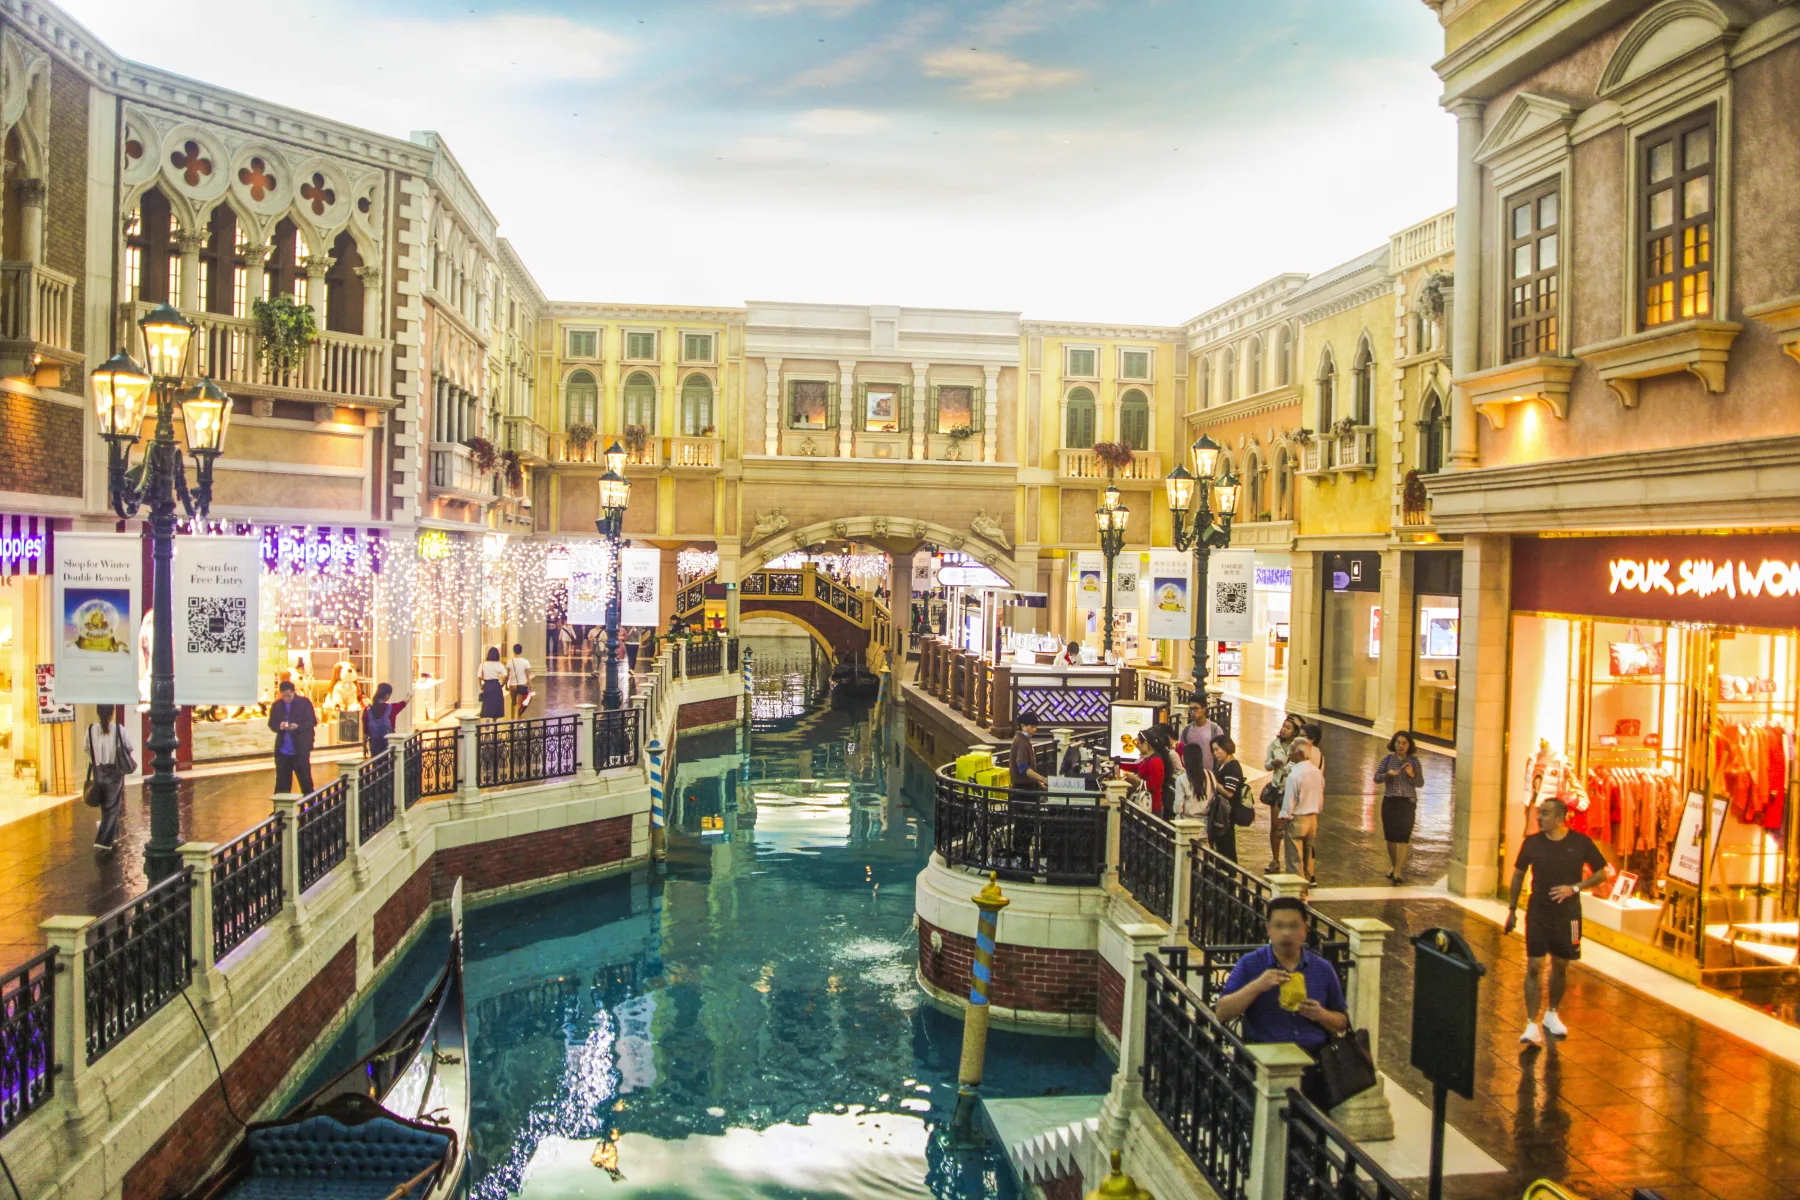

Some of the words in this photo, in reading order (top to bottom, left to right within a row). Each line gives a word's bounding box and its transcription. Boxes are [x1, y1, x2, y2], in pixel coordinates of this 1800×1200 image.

[64, 559, 85, 570] Shop
[87, 560, 98, 568] for
[100, 559, 131, 569] Winter
[196, 562, 221, 572] Scan
[223, 562, 239, 572] for
[63, 572, 94, 582] Double
[95, 573, 132, 582] Rewards
[191, 574, 214, 584] Free
[216, 574, 244, 588] Entry
